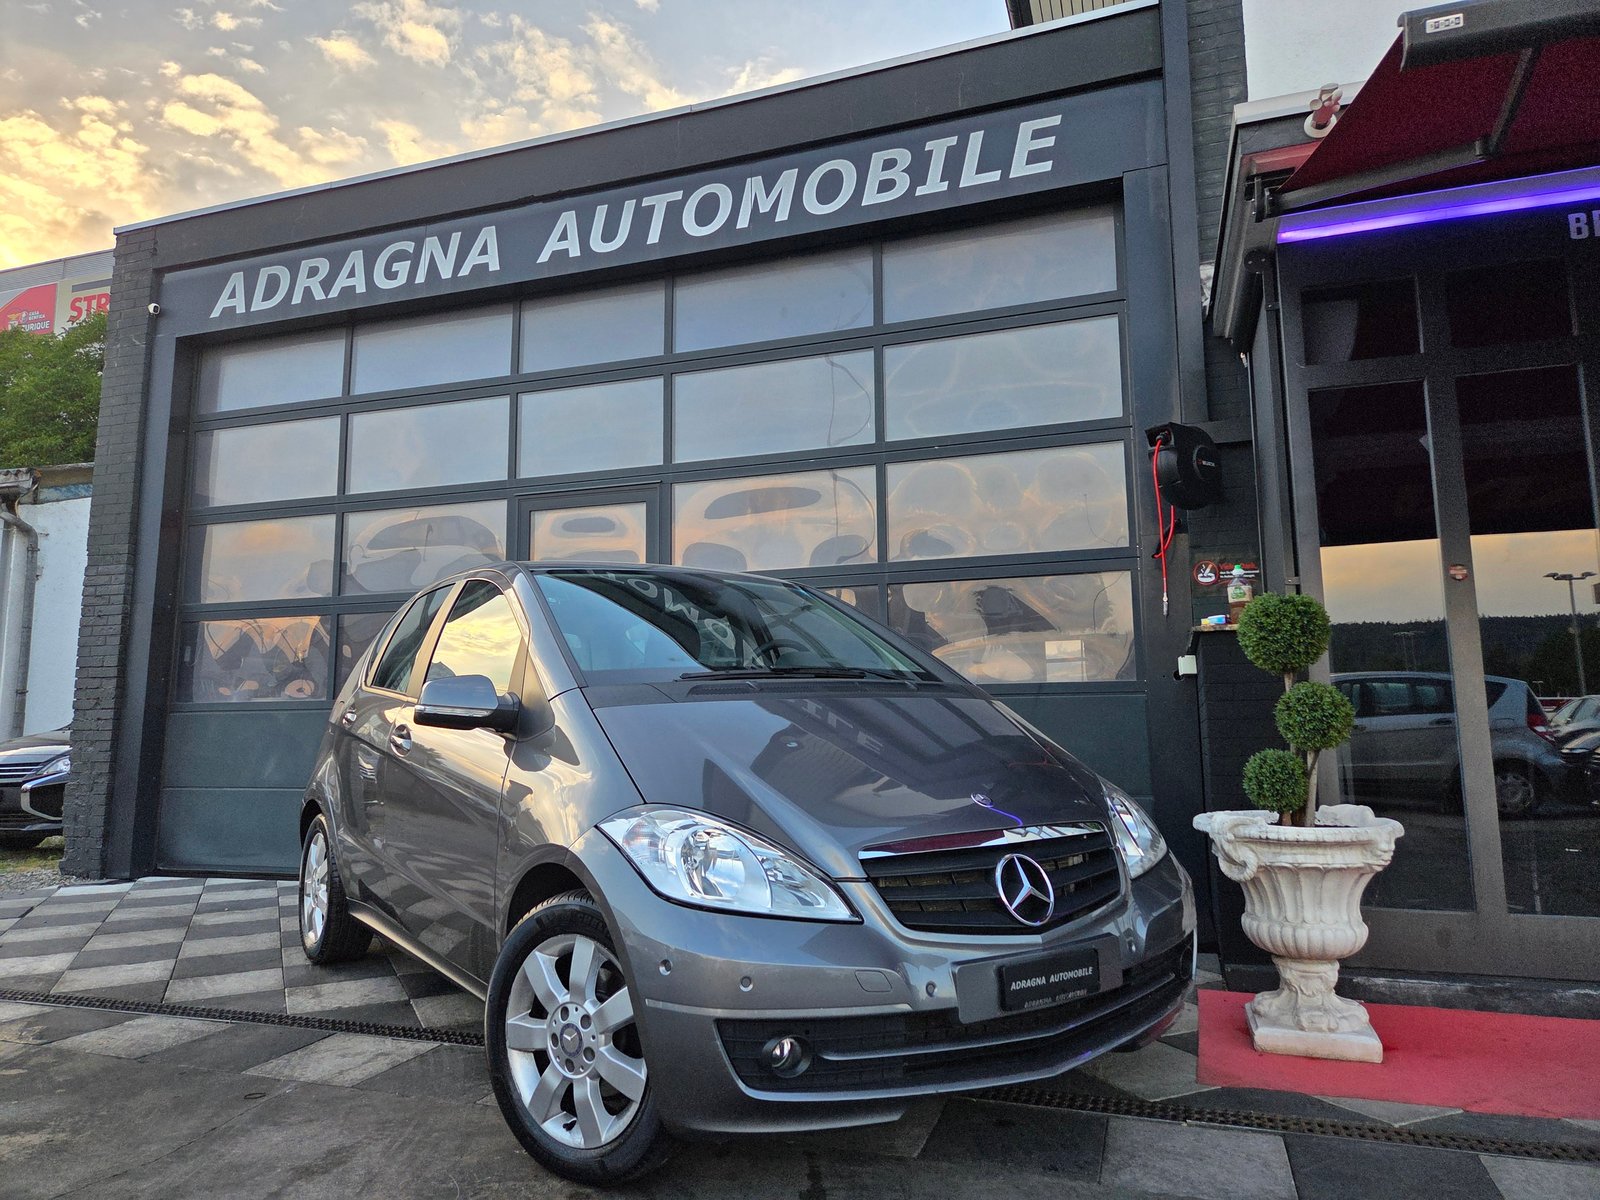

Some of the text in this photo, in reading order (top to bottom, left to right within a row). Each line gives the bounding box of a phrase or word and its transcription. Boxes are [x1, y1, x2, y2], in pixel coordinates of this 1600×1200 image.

[209, 114, 1062, 319] ADRAGNA AUTOMOBILE
[1010, 966, 1093, 991] ADRAGNA AUTOMOBILE
